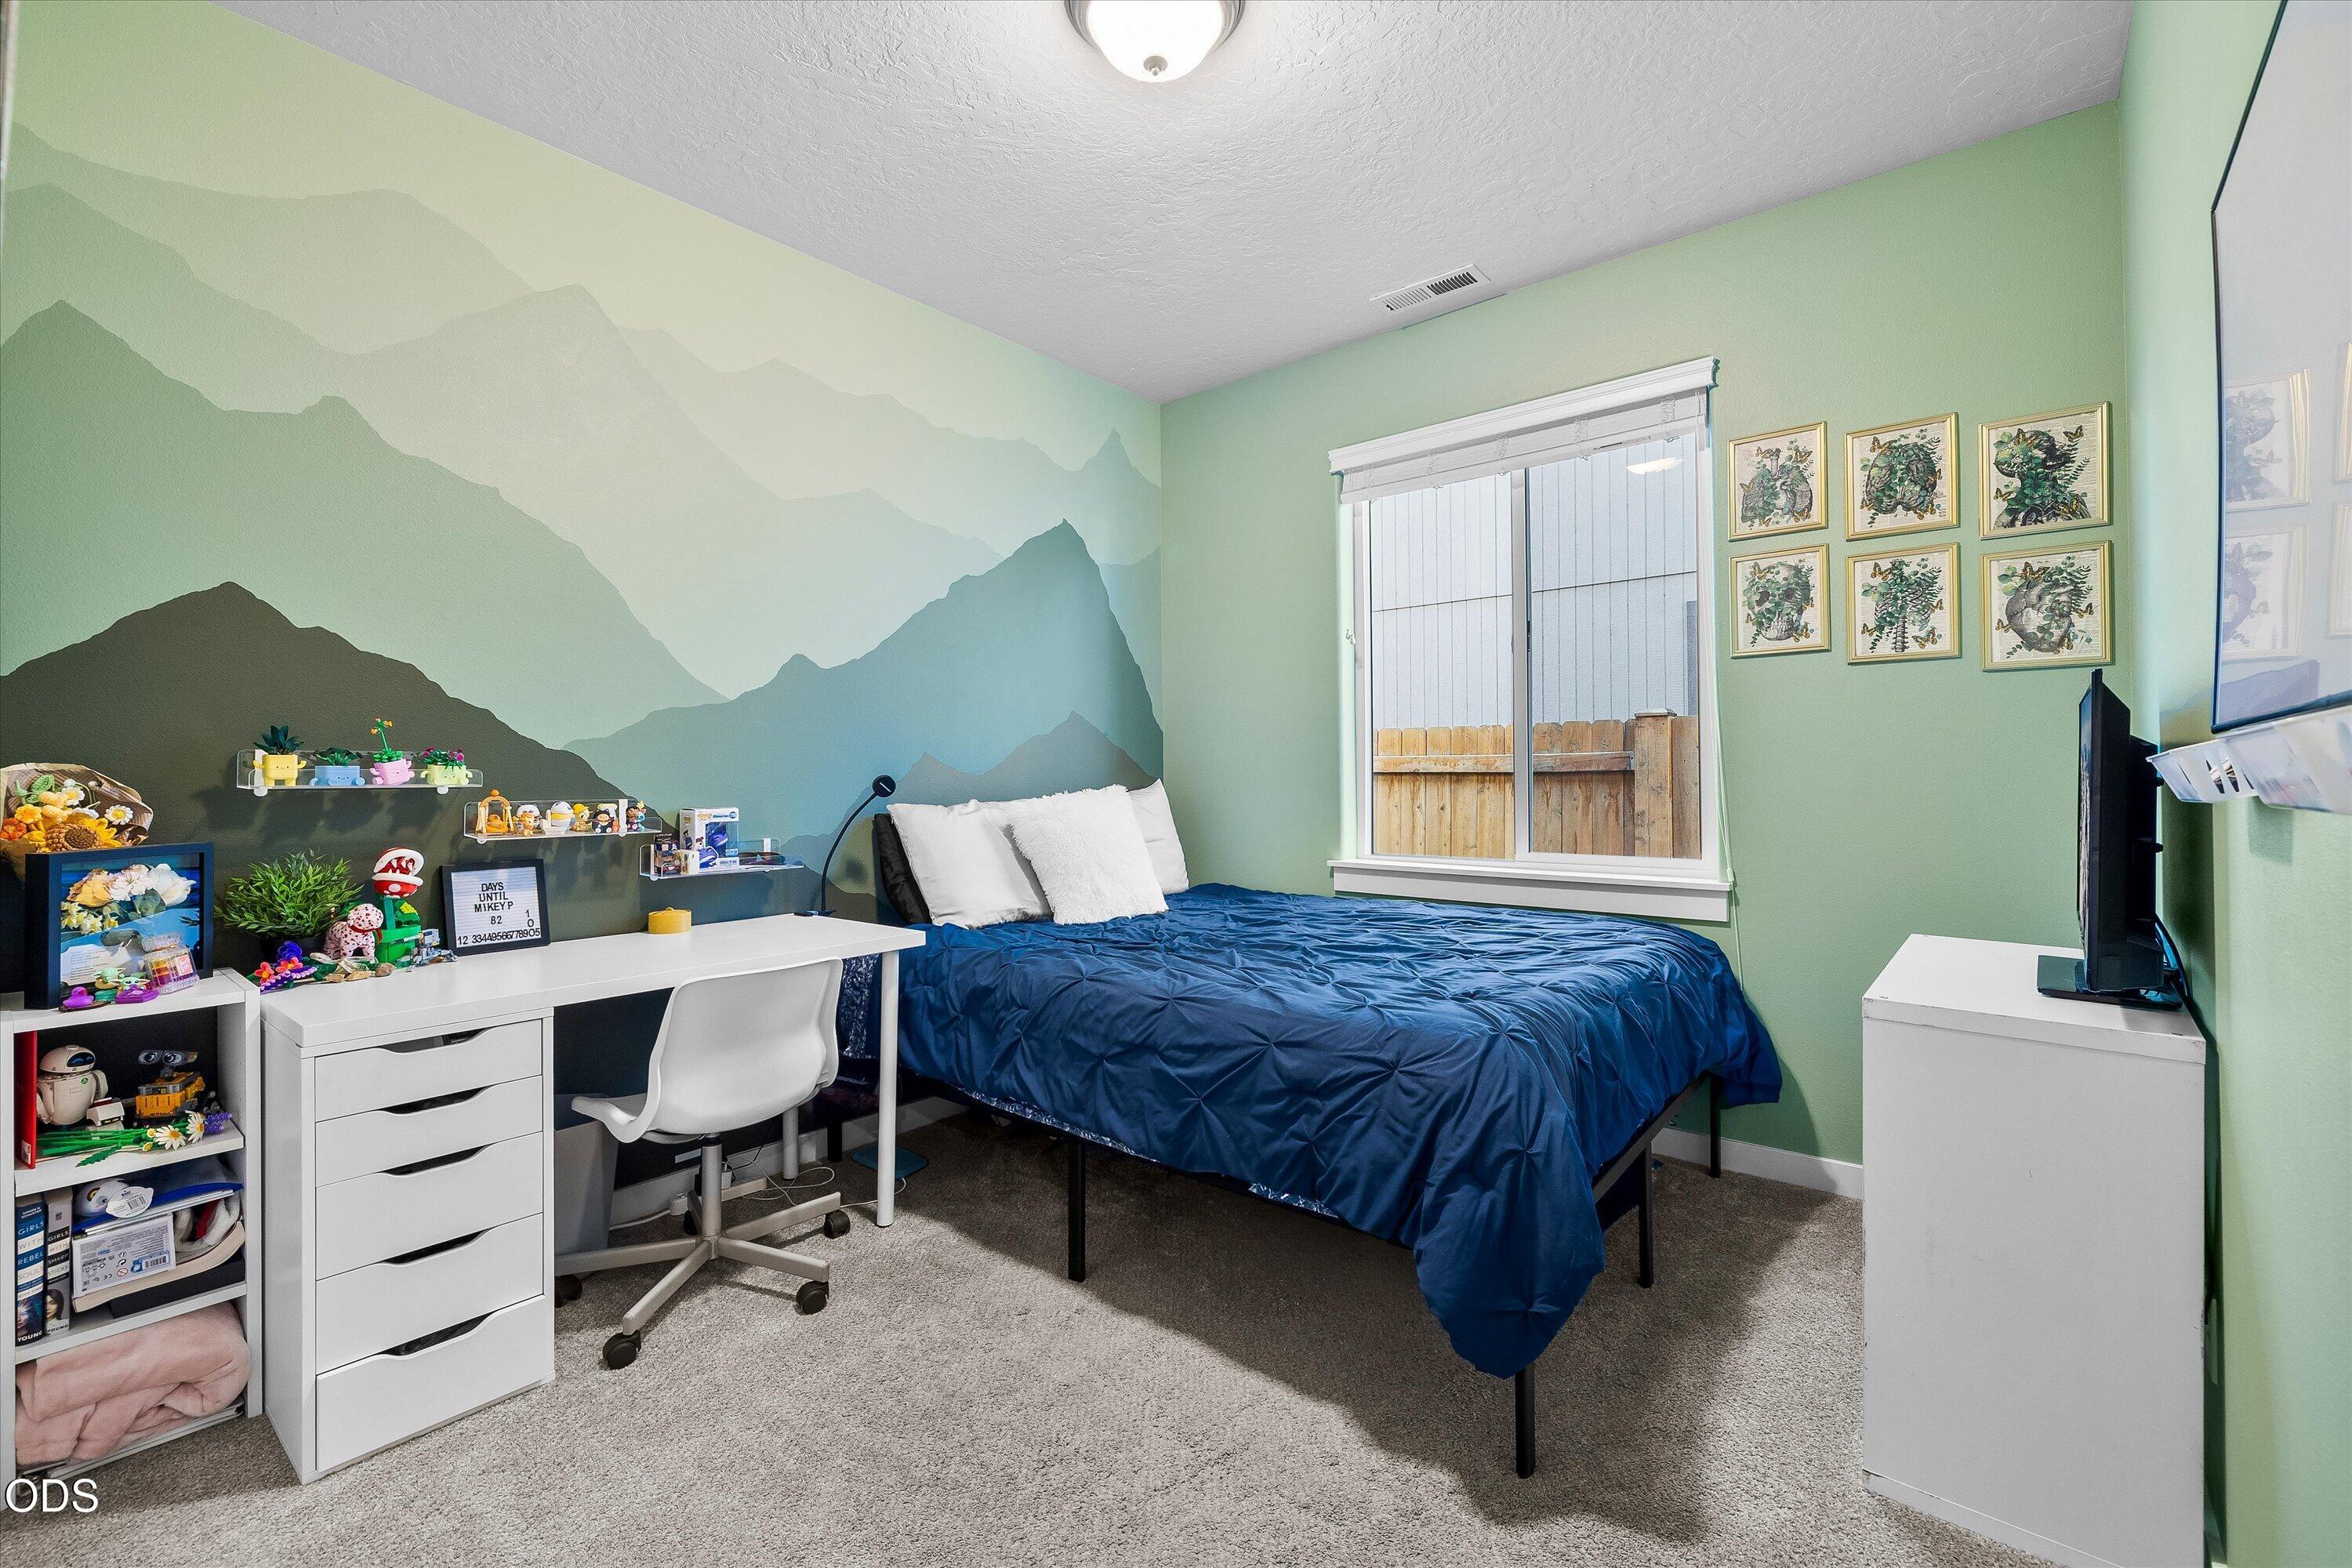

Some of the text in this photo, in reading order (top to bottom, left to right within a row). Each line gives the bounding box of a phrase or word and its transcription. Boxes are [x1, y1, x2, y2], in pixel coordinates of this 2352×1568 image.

[481, 882, 504, 892] DAYS
[479, 891, 509, 902] UNTIL
[474, 901, 514, 913] MIKEY P
[524, 909, 530, 918] 1
[490, 915, 503, 925] 82
[457, 935, 469, 946] 12
[17, 1221, 44, 1236] GIRLS
[48, 1230, 69, 1242] GIRLS
[49, 1242, 68, 1253] WITH
[17, 1251, 43, 1266] REBEL
[47, 1253, 69, 1265] SHARP
[48, 1263, 68, 1276] STICKS
[46, 1323, 69, 1334] YOUNG
